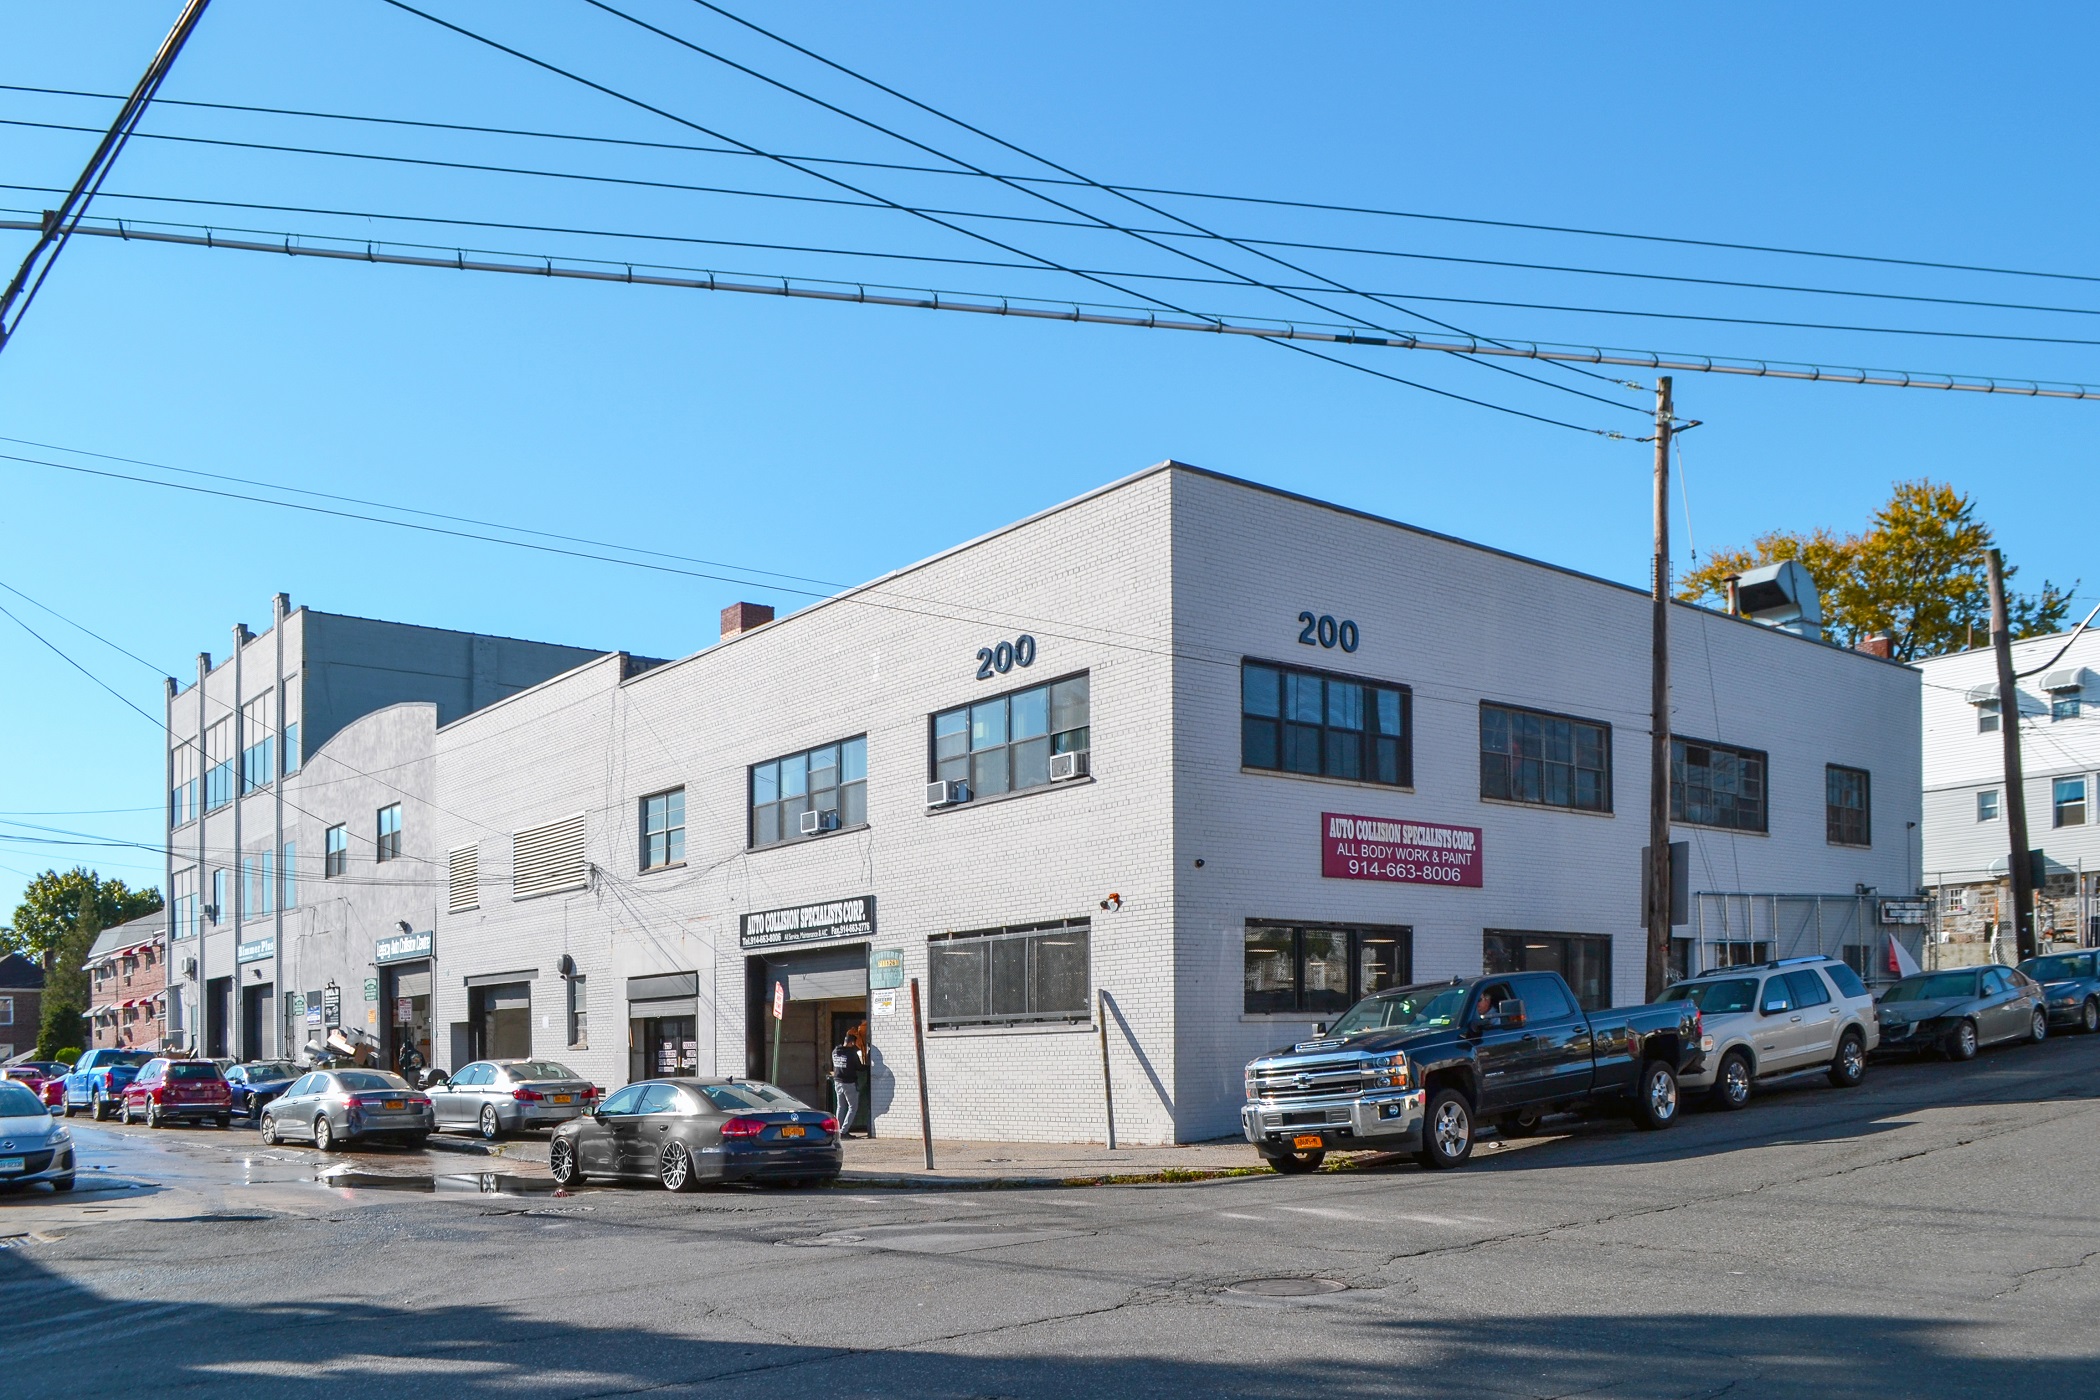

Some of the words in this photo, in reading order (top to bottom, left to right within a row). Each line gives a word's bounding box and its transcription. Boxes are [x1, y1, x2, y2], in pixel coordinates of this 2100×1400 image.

[1298, 611, 1360, 653] 200
[976, 634, 1036, 681] 200
[1329, 817, 1354, 839] AUTO
[1355, 820, 1401, 844] COLLISION
[1402, 825, 1452, 848] SPECIALISTS
[1452, 830, 1476, 851] CORP.
[1337, 842, 1358, 857] ALL
[1361, 845, 1393, 859] BODY
[1395, 847, 1429, 862] WORK
[1432, 851, 1440, 863] &
[1442, 851, 1472, 865] PAINT
[1348, 859, 1461, 882] 914-663-8006
[746, 914, 765, 935] AUTO
[765, 909, 800, 932] COLLISION
[800, 902, 843, 929] SPECIALISTS
[843, 900, 866, 923] CORP.
[238, 944, 261, 957] Bimmer
[261, 940, 274, 952] Plus
